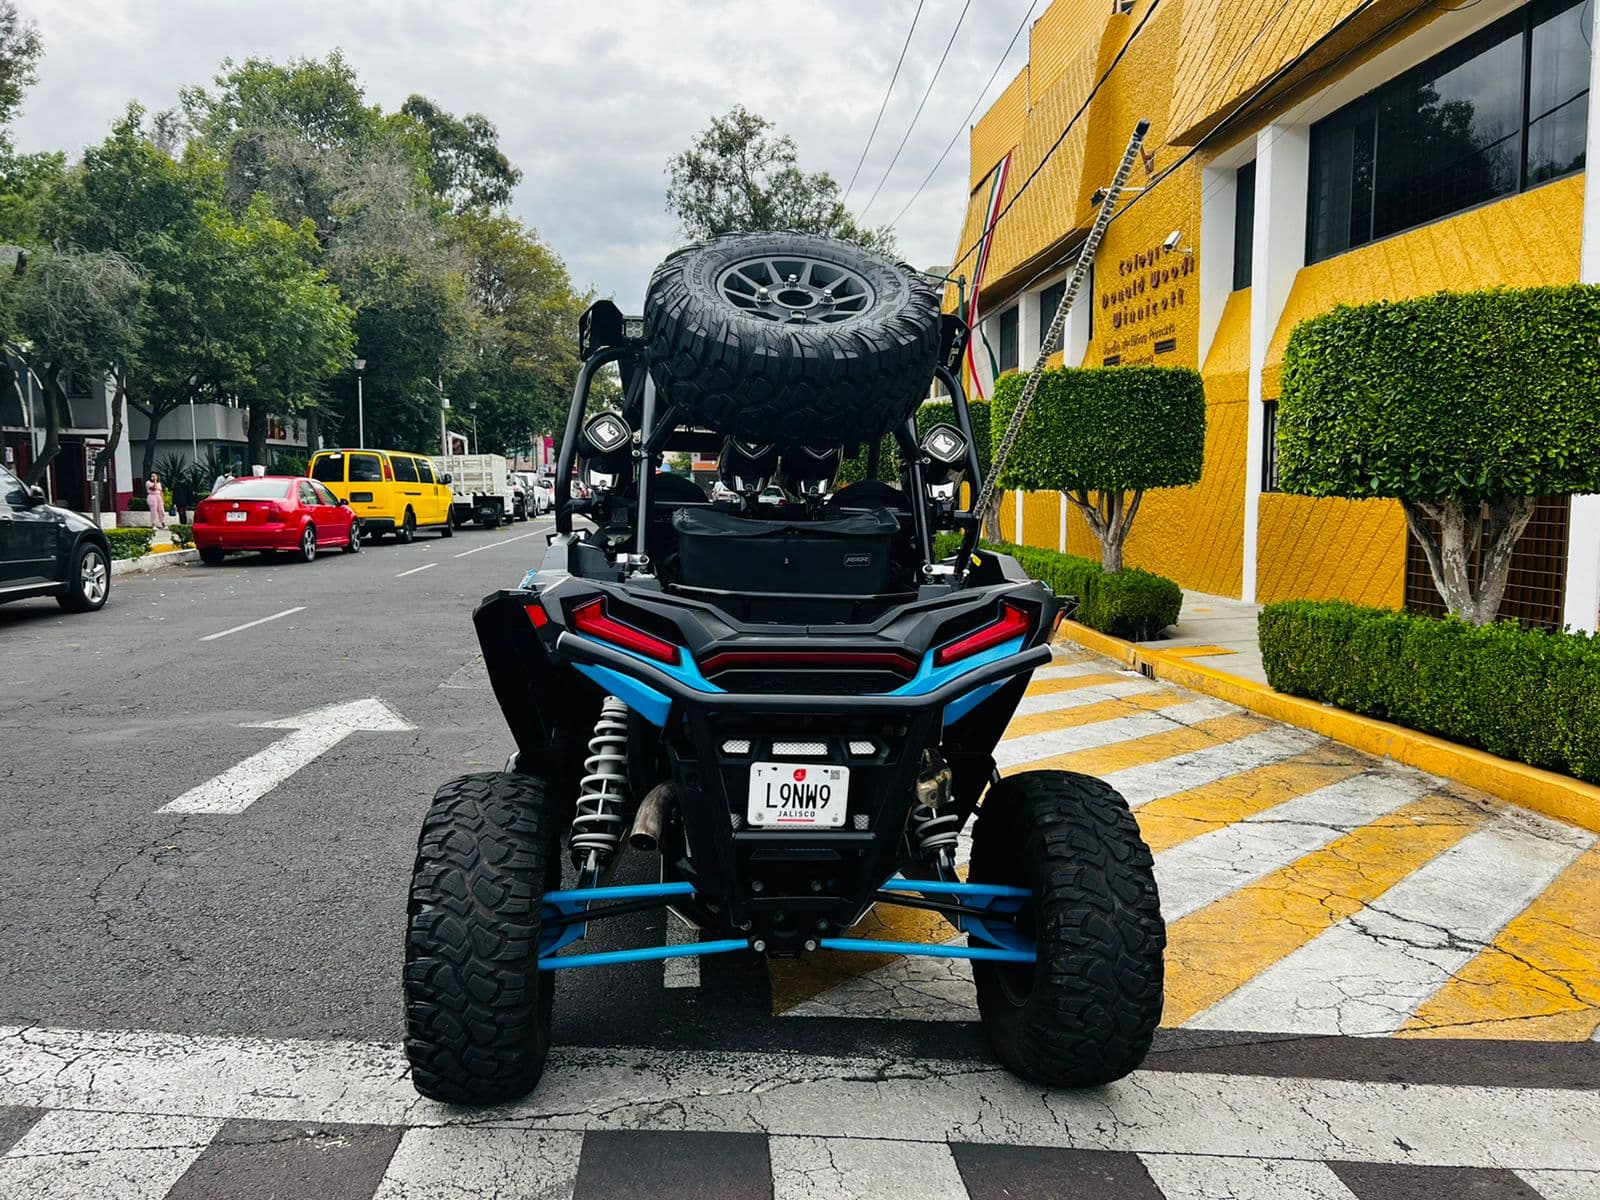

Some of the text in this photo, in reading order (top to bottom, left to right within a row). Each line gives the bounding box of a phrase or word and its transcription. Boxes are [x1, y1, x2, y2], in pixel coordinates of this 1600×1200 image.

[1119, 245, 1161, 277] Colegi
[1102, 276, 1145, 310] Donald
[757, 769, 762, 777] T
[766, 782, 831, 810] L9NW9
[777, 810, 816, 818] JALISCO
